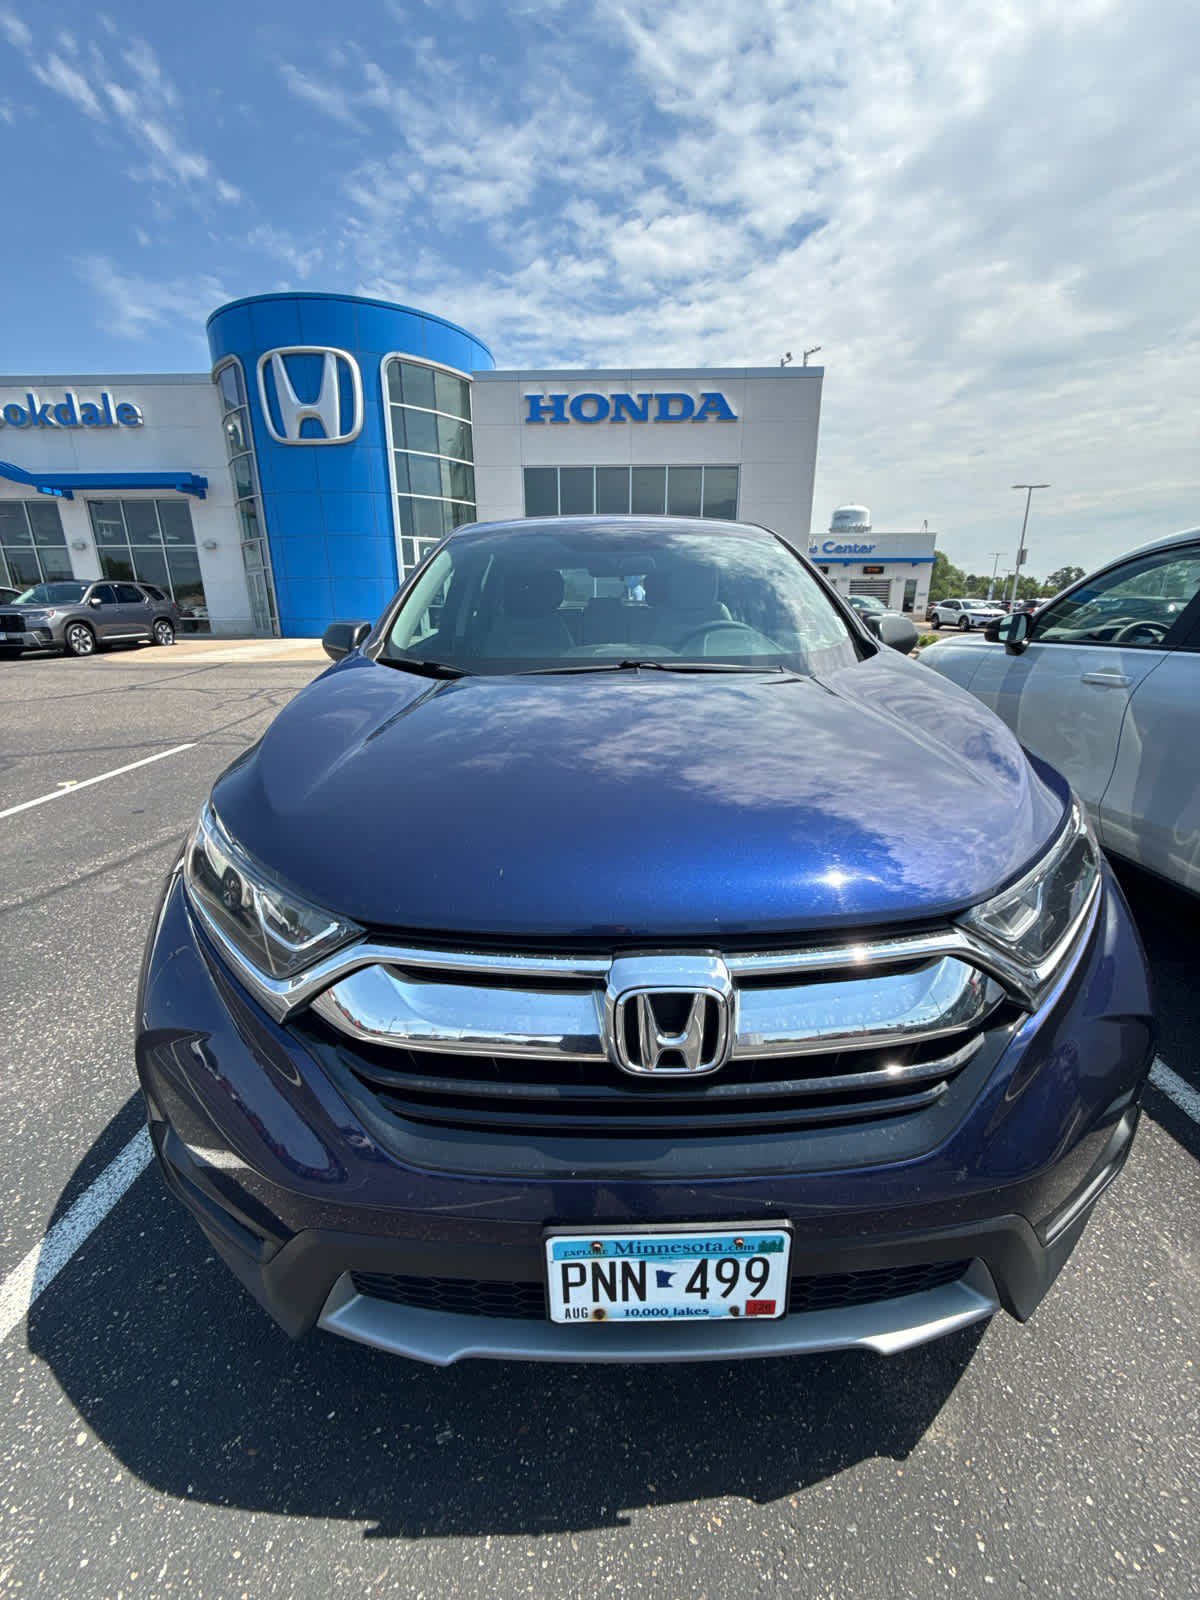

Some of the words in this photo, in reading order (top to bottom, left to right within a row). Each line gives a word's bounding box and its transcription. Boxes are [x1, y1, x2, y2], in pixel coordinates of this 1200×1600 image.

[523, 391, 739, 425] HONDA
[822, 540, 877, 554] Center
[563, 1248, 609, 1257] EXPLE
[561, 1260, 647, 1304] PNN
[684, 1256, 771, 1300] 499
[564, 1306, 589, 1320] AUG
[623, 1307, 669, 1318] 10,000
[673, 1306, 710, 1316] lakes
